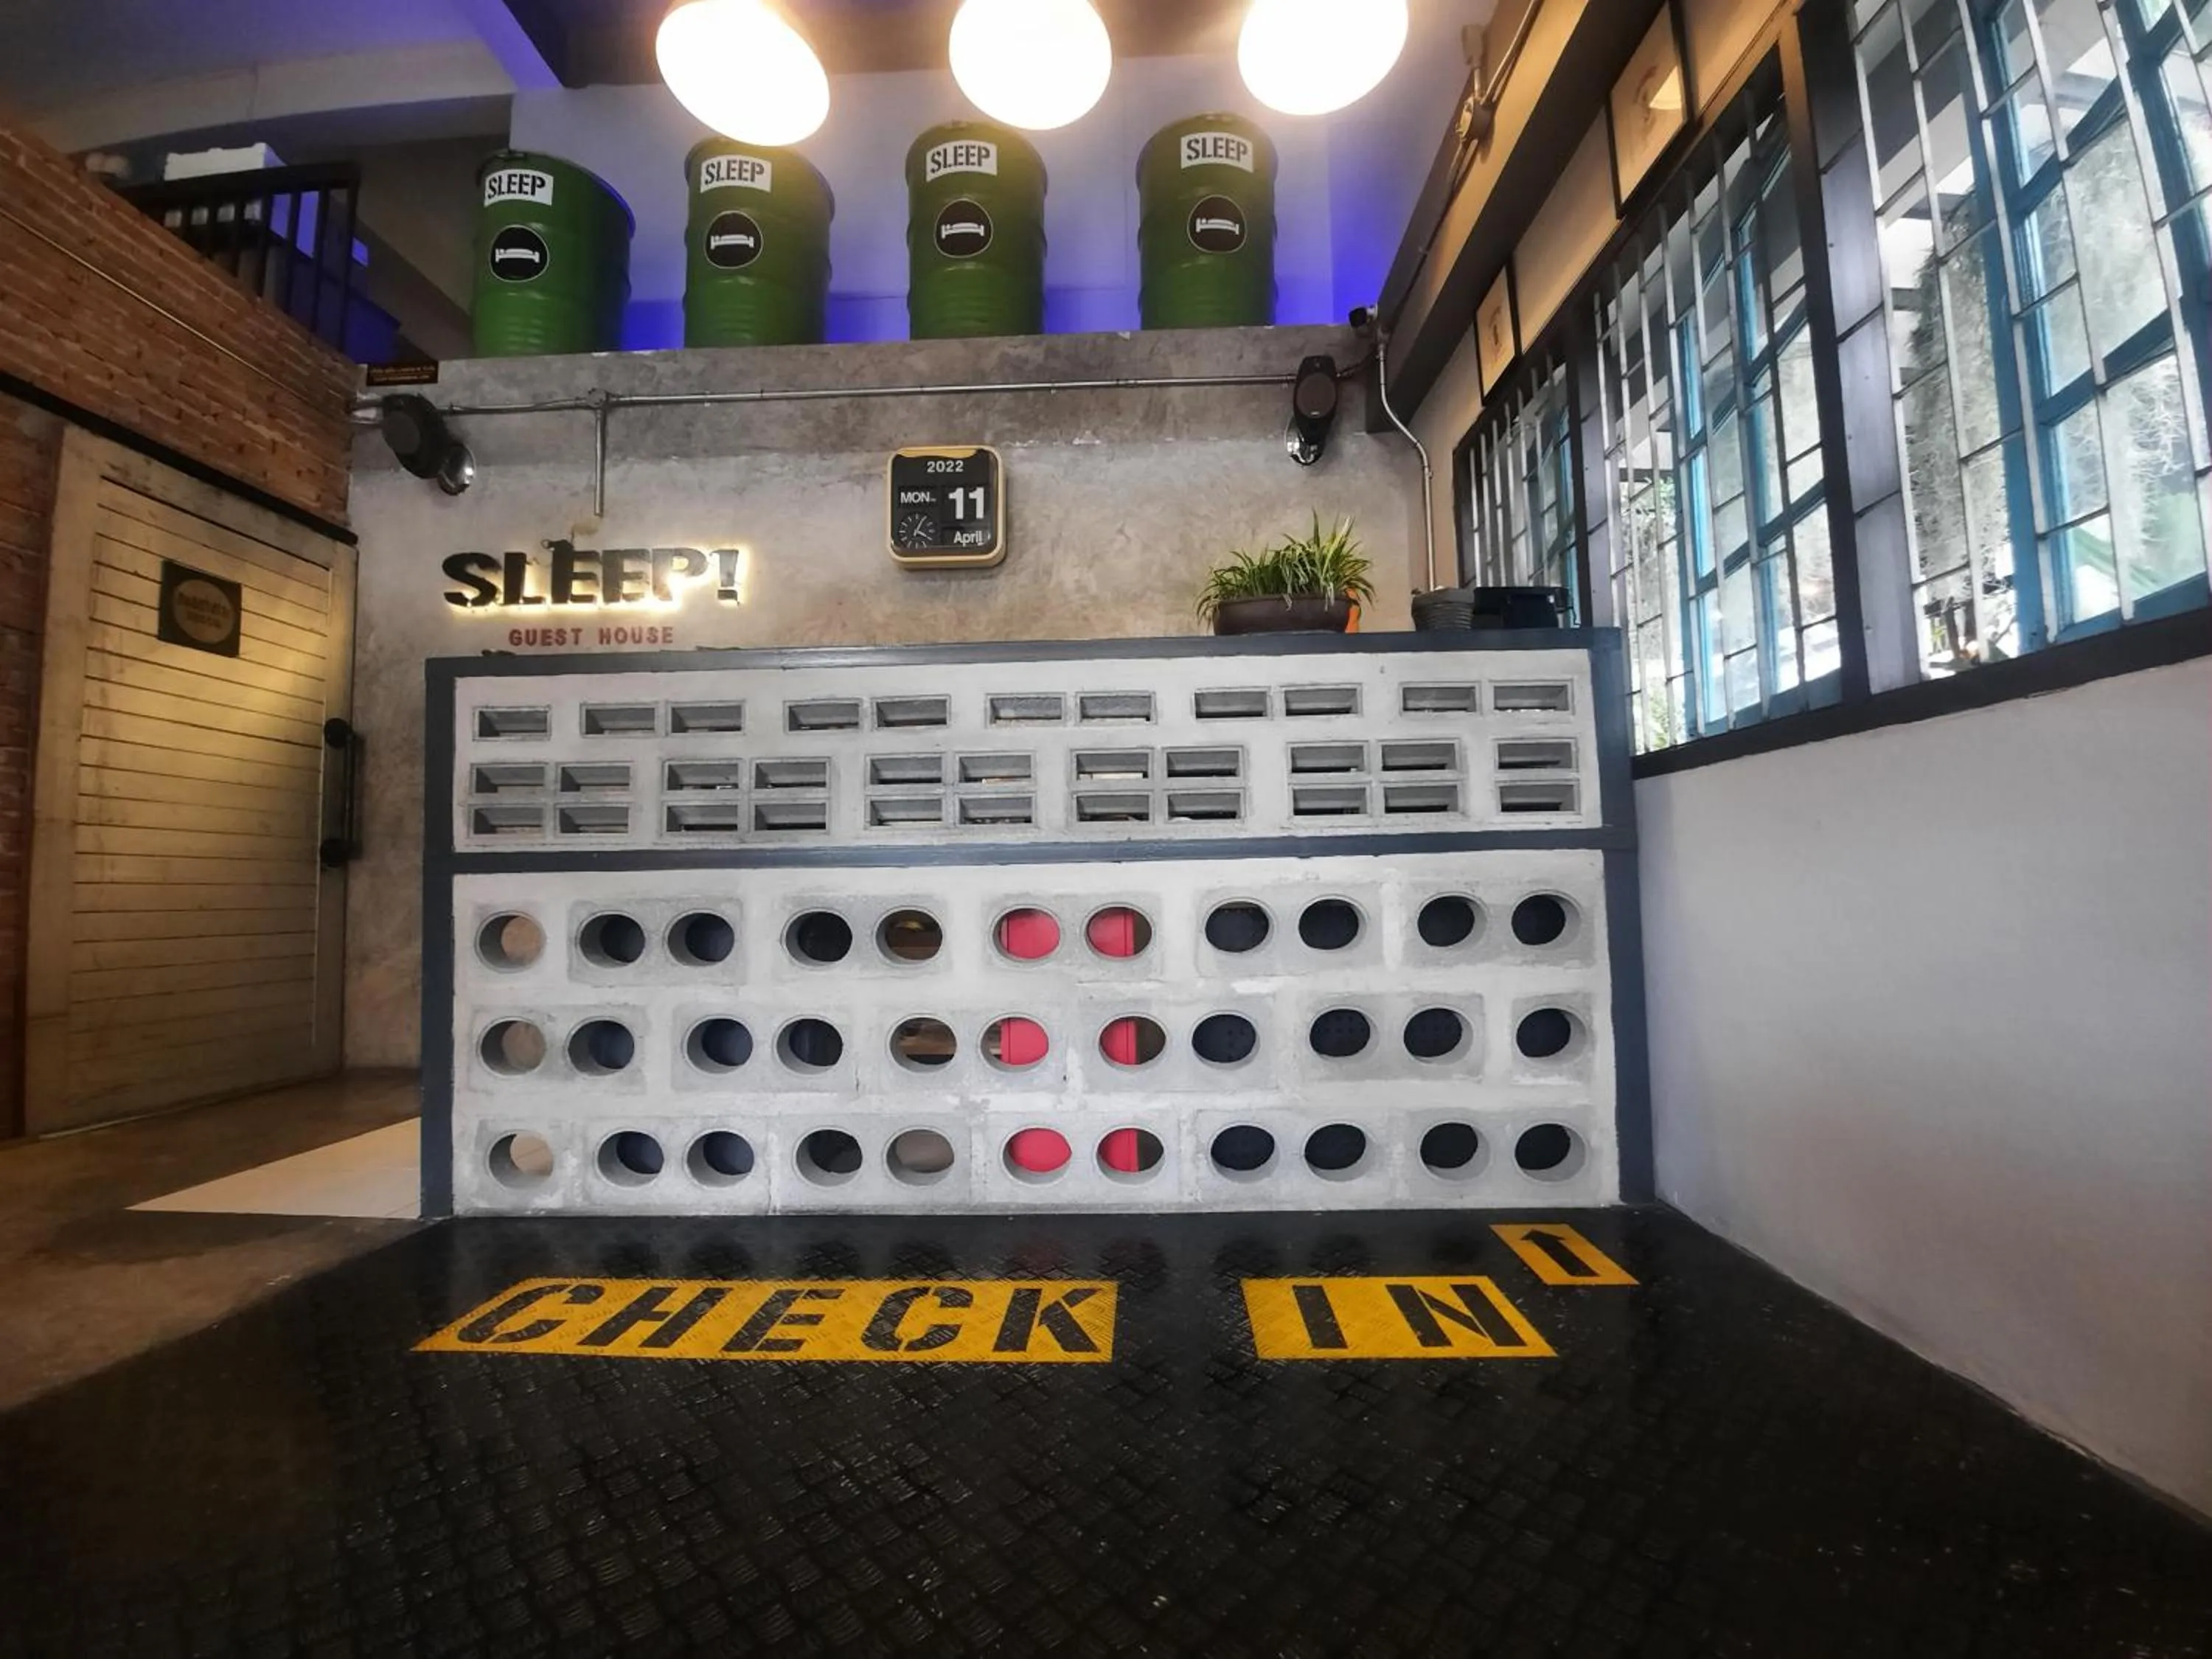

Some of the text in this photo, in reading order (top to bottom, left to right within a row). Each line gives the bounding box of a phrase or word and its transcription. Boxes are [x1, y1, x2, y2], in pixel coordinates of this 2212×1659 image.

[931, 145, 990, 173] SLEEP
[1186, 137, 1248, 161] SLEEP
[705, 159, 765, 184] SLEEP
[487, 174, 546, 198] SLEEP
[927, 460, 963, 473] 2022
[948, 487, 984, 520] 11
[953, 530, 983, 546] April
[442, 548, 740, 608] SLEEP!
[509, 627, 675, 647] GUEST HOUSE
[457, 1283, 1528, 1354] CHECK IN
